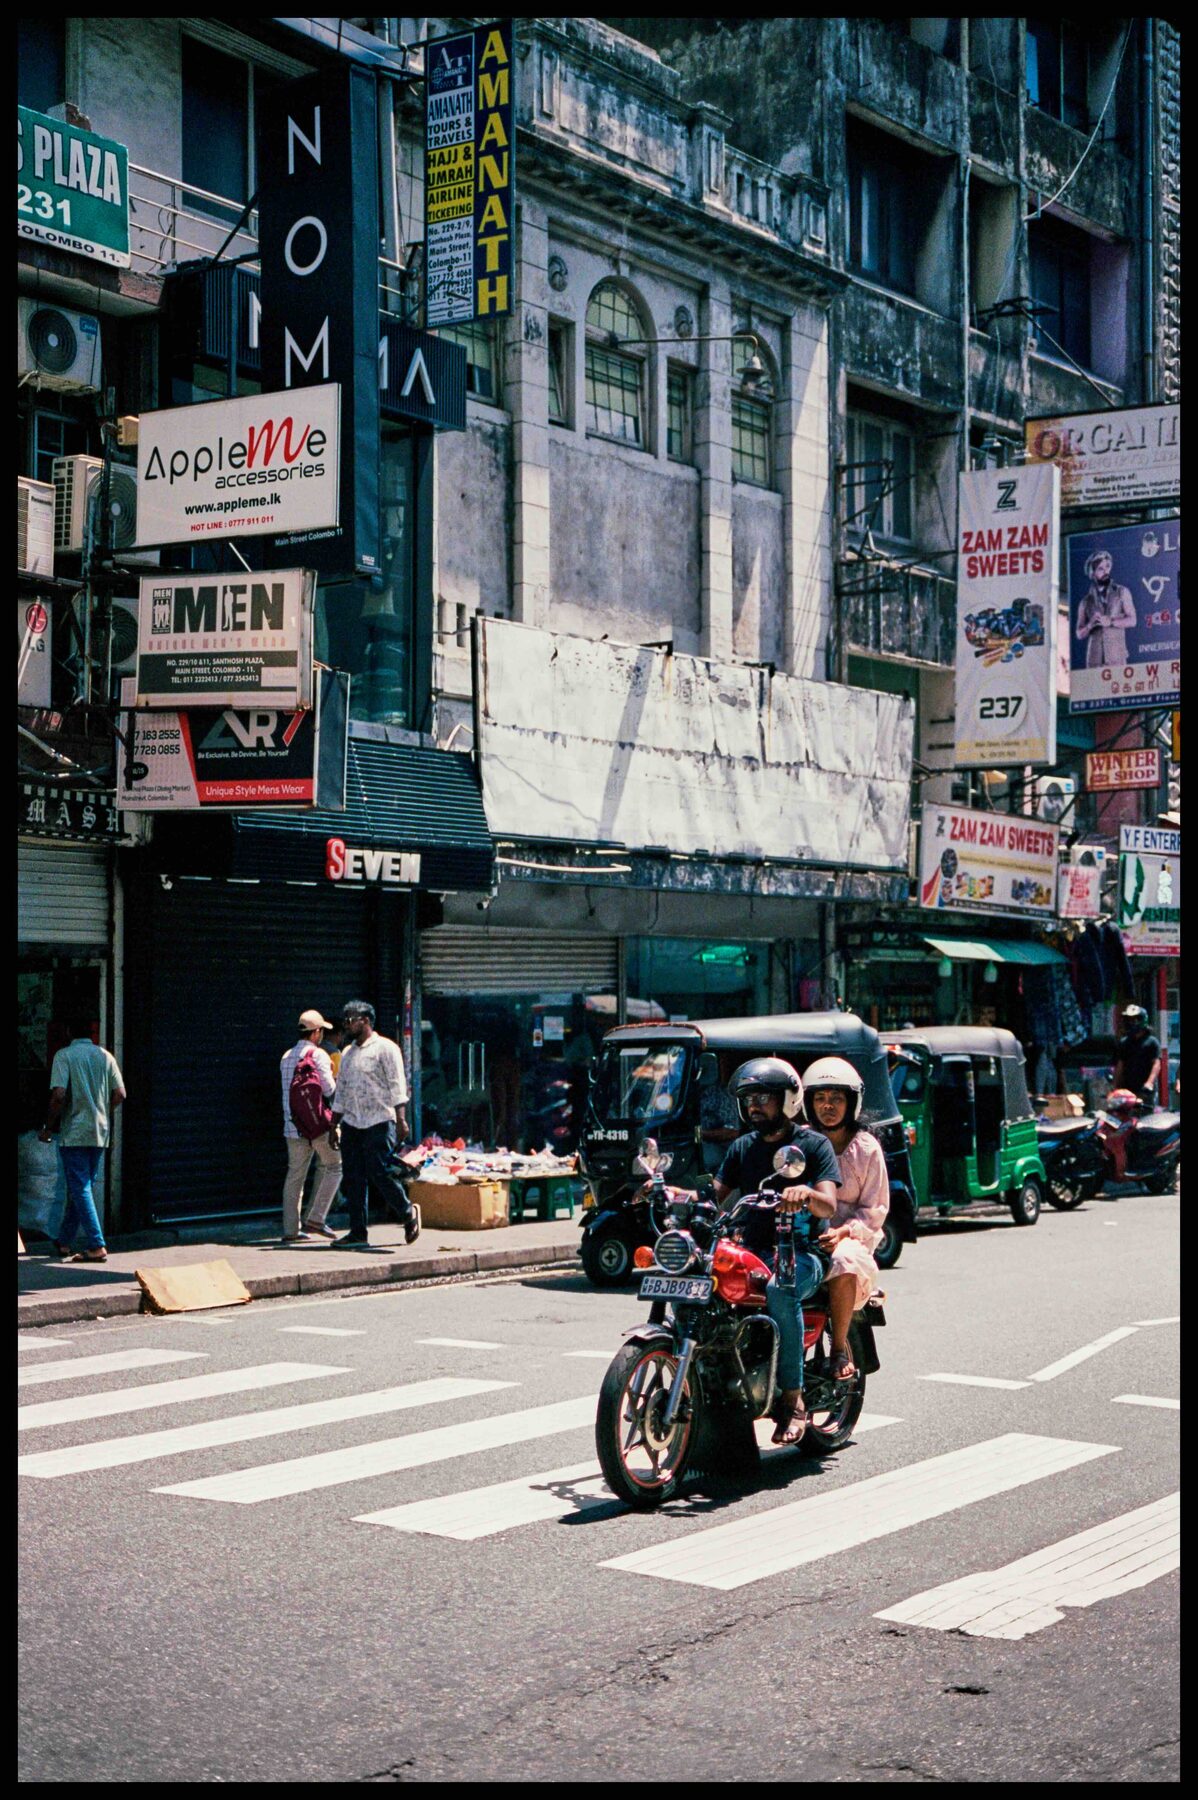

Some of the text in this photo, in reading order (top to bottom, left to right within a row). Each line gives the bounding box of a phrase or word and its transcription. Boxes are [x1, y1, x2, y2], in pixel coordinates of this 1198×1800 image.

[428, 91, 473, 121] AMANATH
[428, 116, 473, 135] TOURS &
[428, 129, 473, 148] TRAVELS
[33, 124, 122, 207] PLAZA
[428, 145, 473, 168] HAJJ &
[428, 164, 473, 186] UMRAH
[478, 29, 509, 315] AMANATH
[428, 185, 473, 205] AIRLINE
[428, 203, 473, 221] TICKETING
[18, 222, 95, 253] OLOMBO
[214, 462, 325, 489] accessories
[185, 493, 282, 515] www.appleme.lk
[191, 523, 205, 532] HOT
[207, 521, 223, 530] LINE
[228, 518, 245, 527] 0777
[247, 517, 259, 525] 911
[261, 515, 274, 524] 011
[309, 530, 335, 541] Colombo
[962, 523, 1048, 554] ZAM ZAM
[966, 549, 1044, 579] SWEETS
[153, 588, 172, 598] MEN
[173, 583, 285, 634] MEN
[212, 657, 244, 665] SANTHOSH
[212, 666, 241, 674] COLOMBO
[979, 695, 1023, 719] 237
[158, 729, 180, 739] 2552
[158, 744, 180, 755] 0855
[267, 749, 289, 757] Yourself
[1089, 750, 1156, 772] WINTER
[1114, 769, 1155, 781] SHOP
[205, 784, 304, 797] Unique Style Mens Wear
[950, 816, 977, 844] ZAM
[980, 821, 1006, 848] ZAM
[1008, 826, 1054, 857] SWEETS
